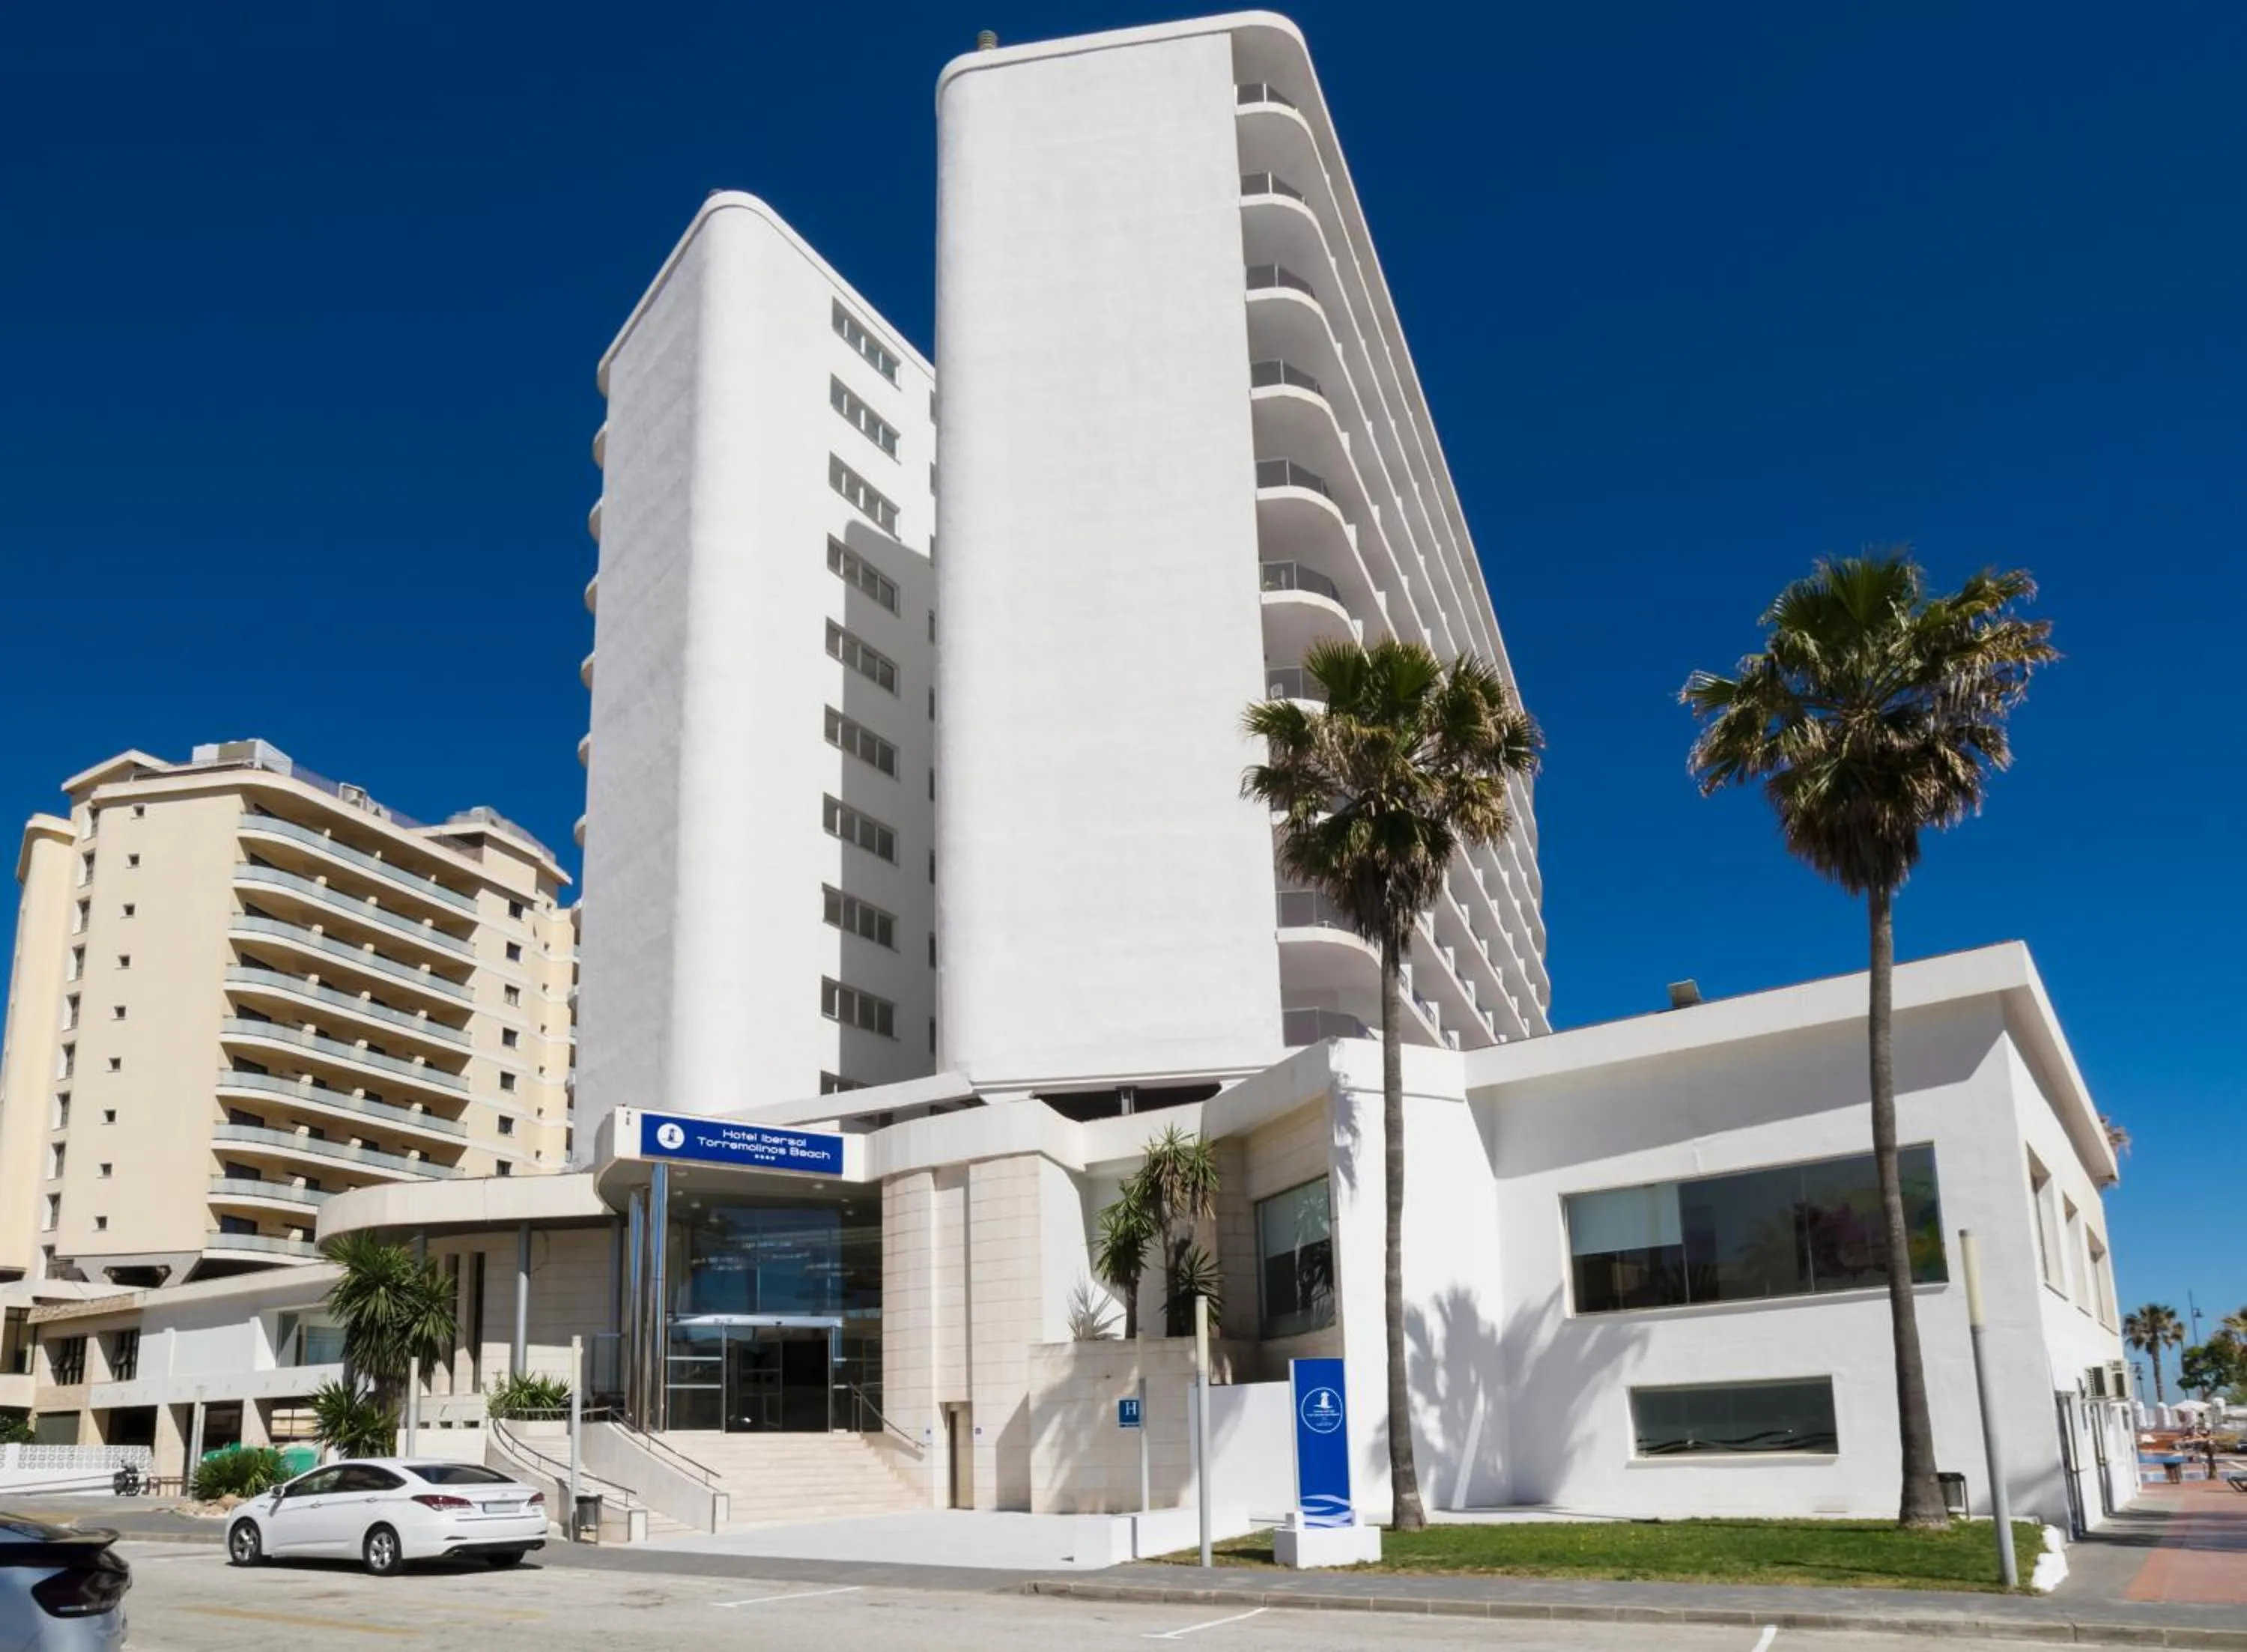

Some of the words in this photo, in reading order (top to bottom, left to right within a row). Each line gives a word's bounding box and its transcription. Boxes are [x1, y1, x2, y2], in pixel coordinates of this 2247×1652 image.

[722, 1129, 757, 1141] Hotel
[761, 1132, 807, 1147] Ibersol
[696, 1136, 786, 1156] Torremolinos
[789, 1147, 831, 1160] Beach
[1125, 1401, 1136, 1415] H
